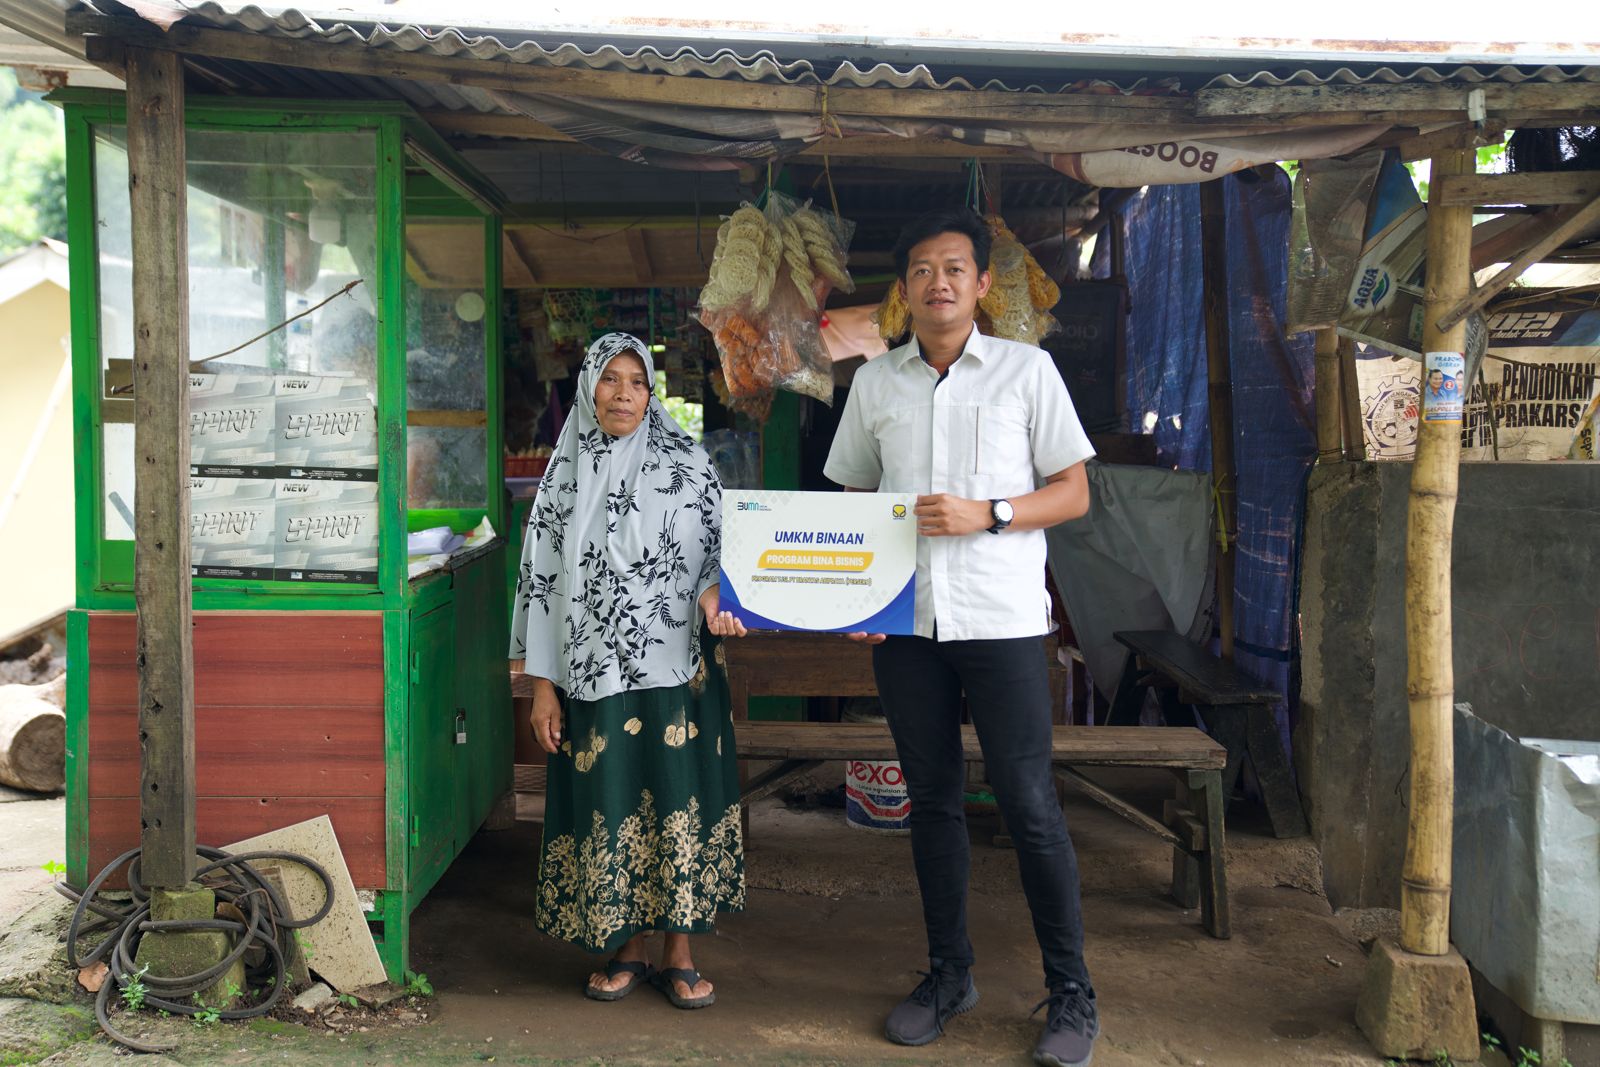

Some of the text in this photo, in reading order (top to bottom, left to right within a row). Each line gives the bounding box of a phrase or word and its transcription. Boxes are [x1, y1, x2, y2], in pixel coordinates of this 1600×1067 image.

[1117, 141, 1219, 173] BOOS
[1353, 268, 1379, 309] AQUA
[282, 379, 310, 389] NEW
[1501, 362, 1596, 401] PENDIDIKAN
[284, 408, 368, 440] SPIRIT
[282, 483, 310, 493] NEW
[284, 511, 368, 543] SPIRIT
[774, 531, 864, 545] UMKM BINAAN
[766, 554, 865, 567] PROGRAM BINA BISNIS
